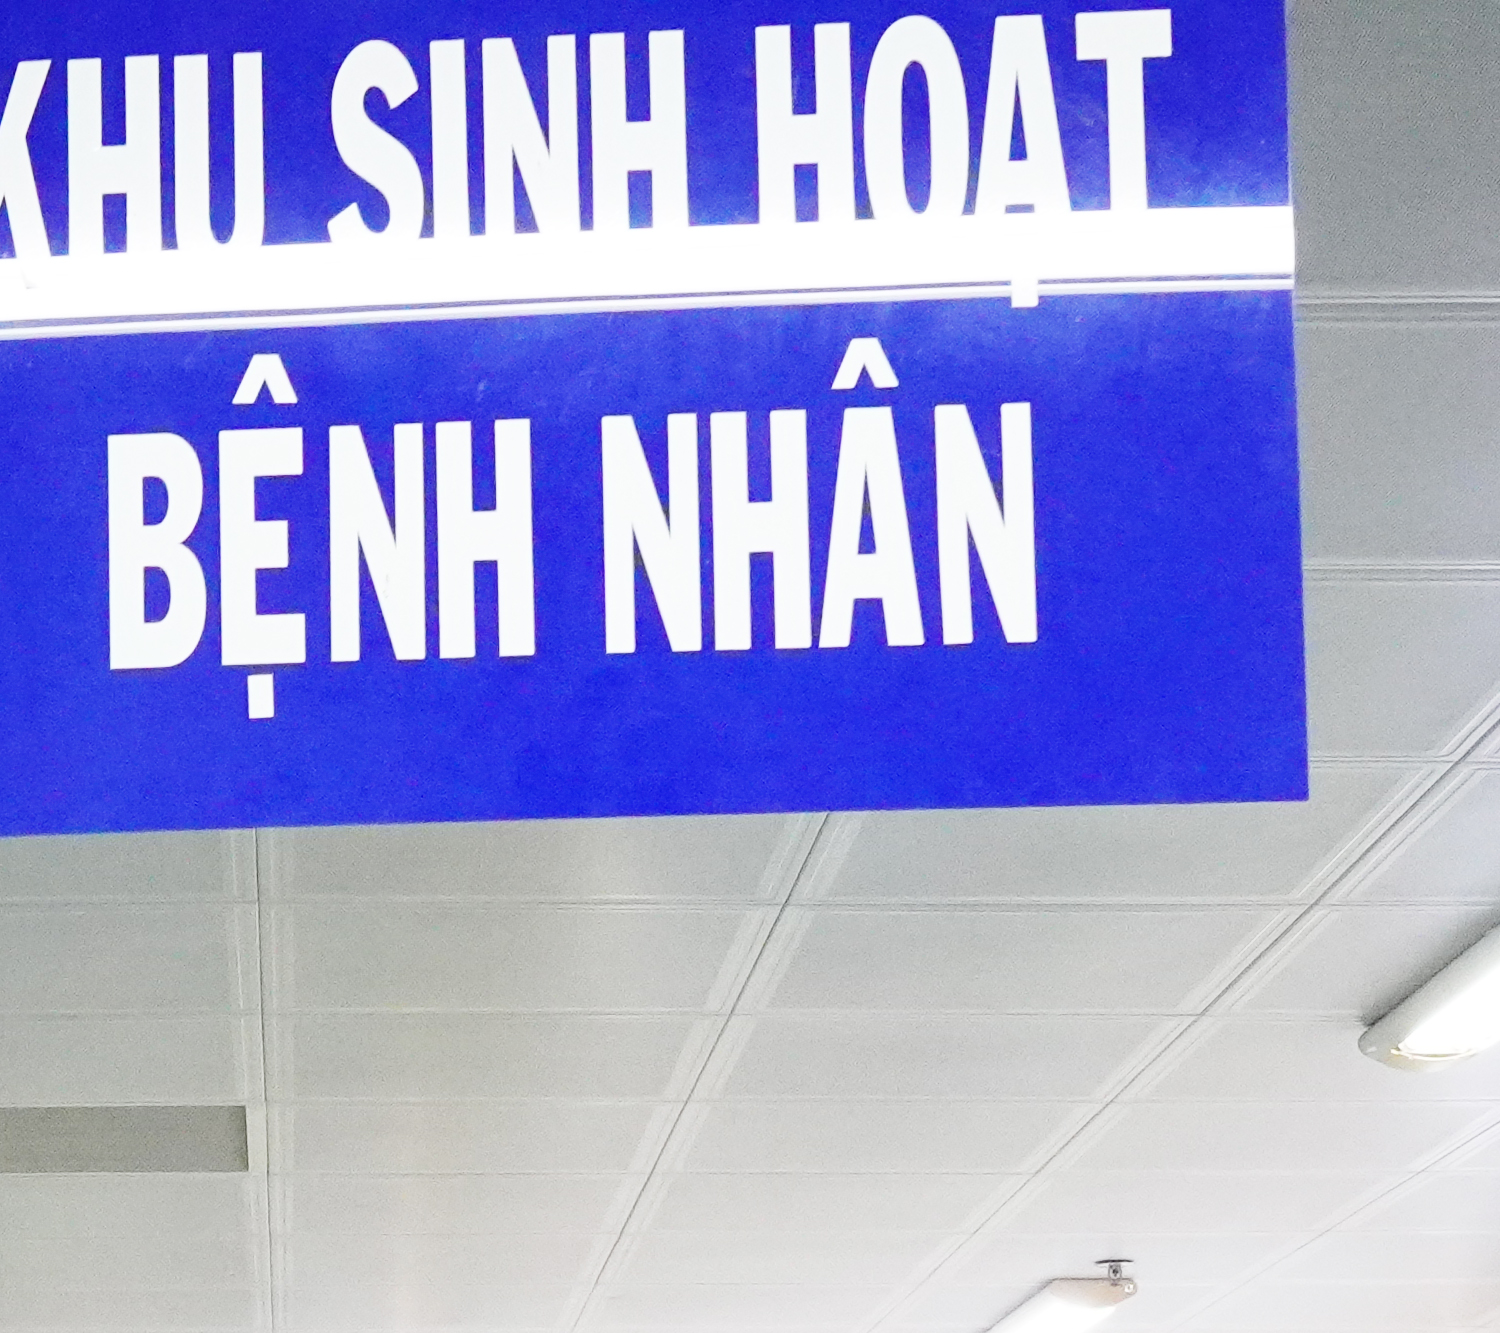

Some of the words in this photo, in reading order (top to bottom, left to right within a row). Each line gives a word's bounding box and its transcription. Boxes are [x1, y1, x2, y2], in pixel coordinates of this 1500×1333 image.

[327, 28, 688, 246] SINH
[755, 7, 1174, 308] HOẠT
[106, 352, 537, 720] BỆNH
[600, 336, 1039, 656] NHÂN
